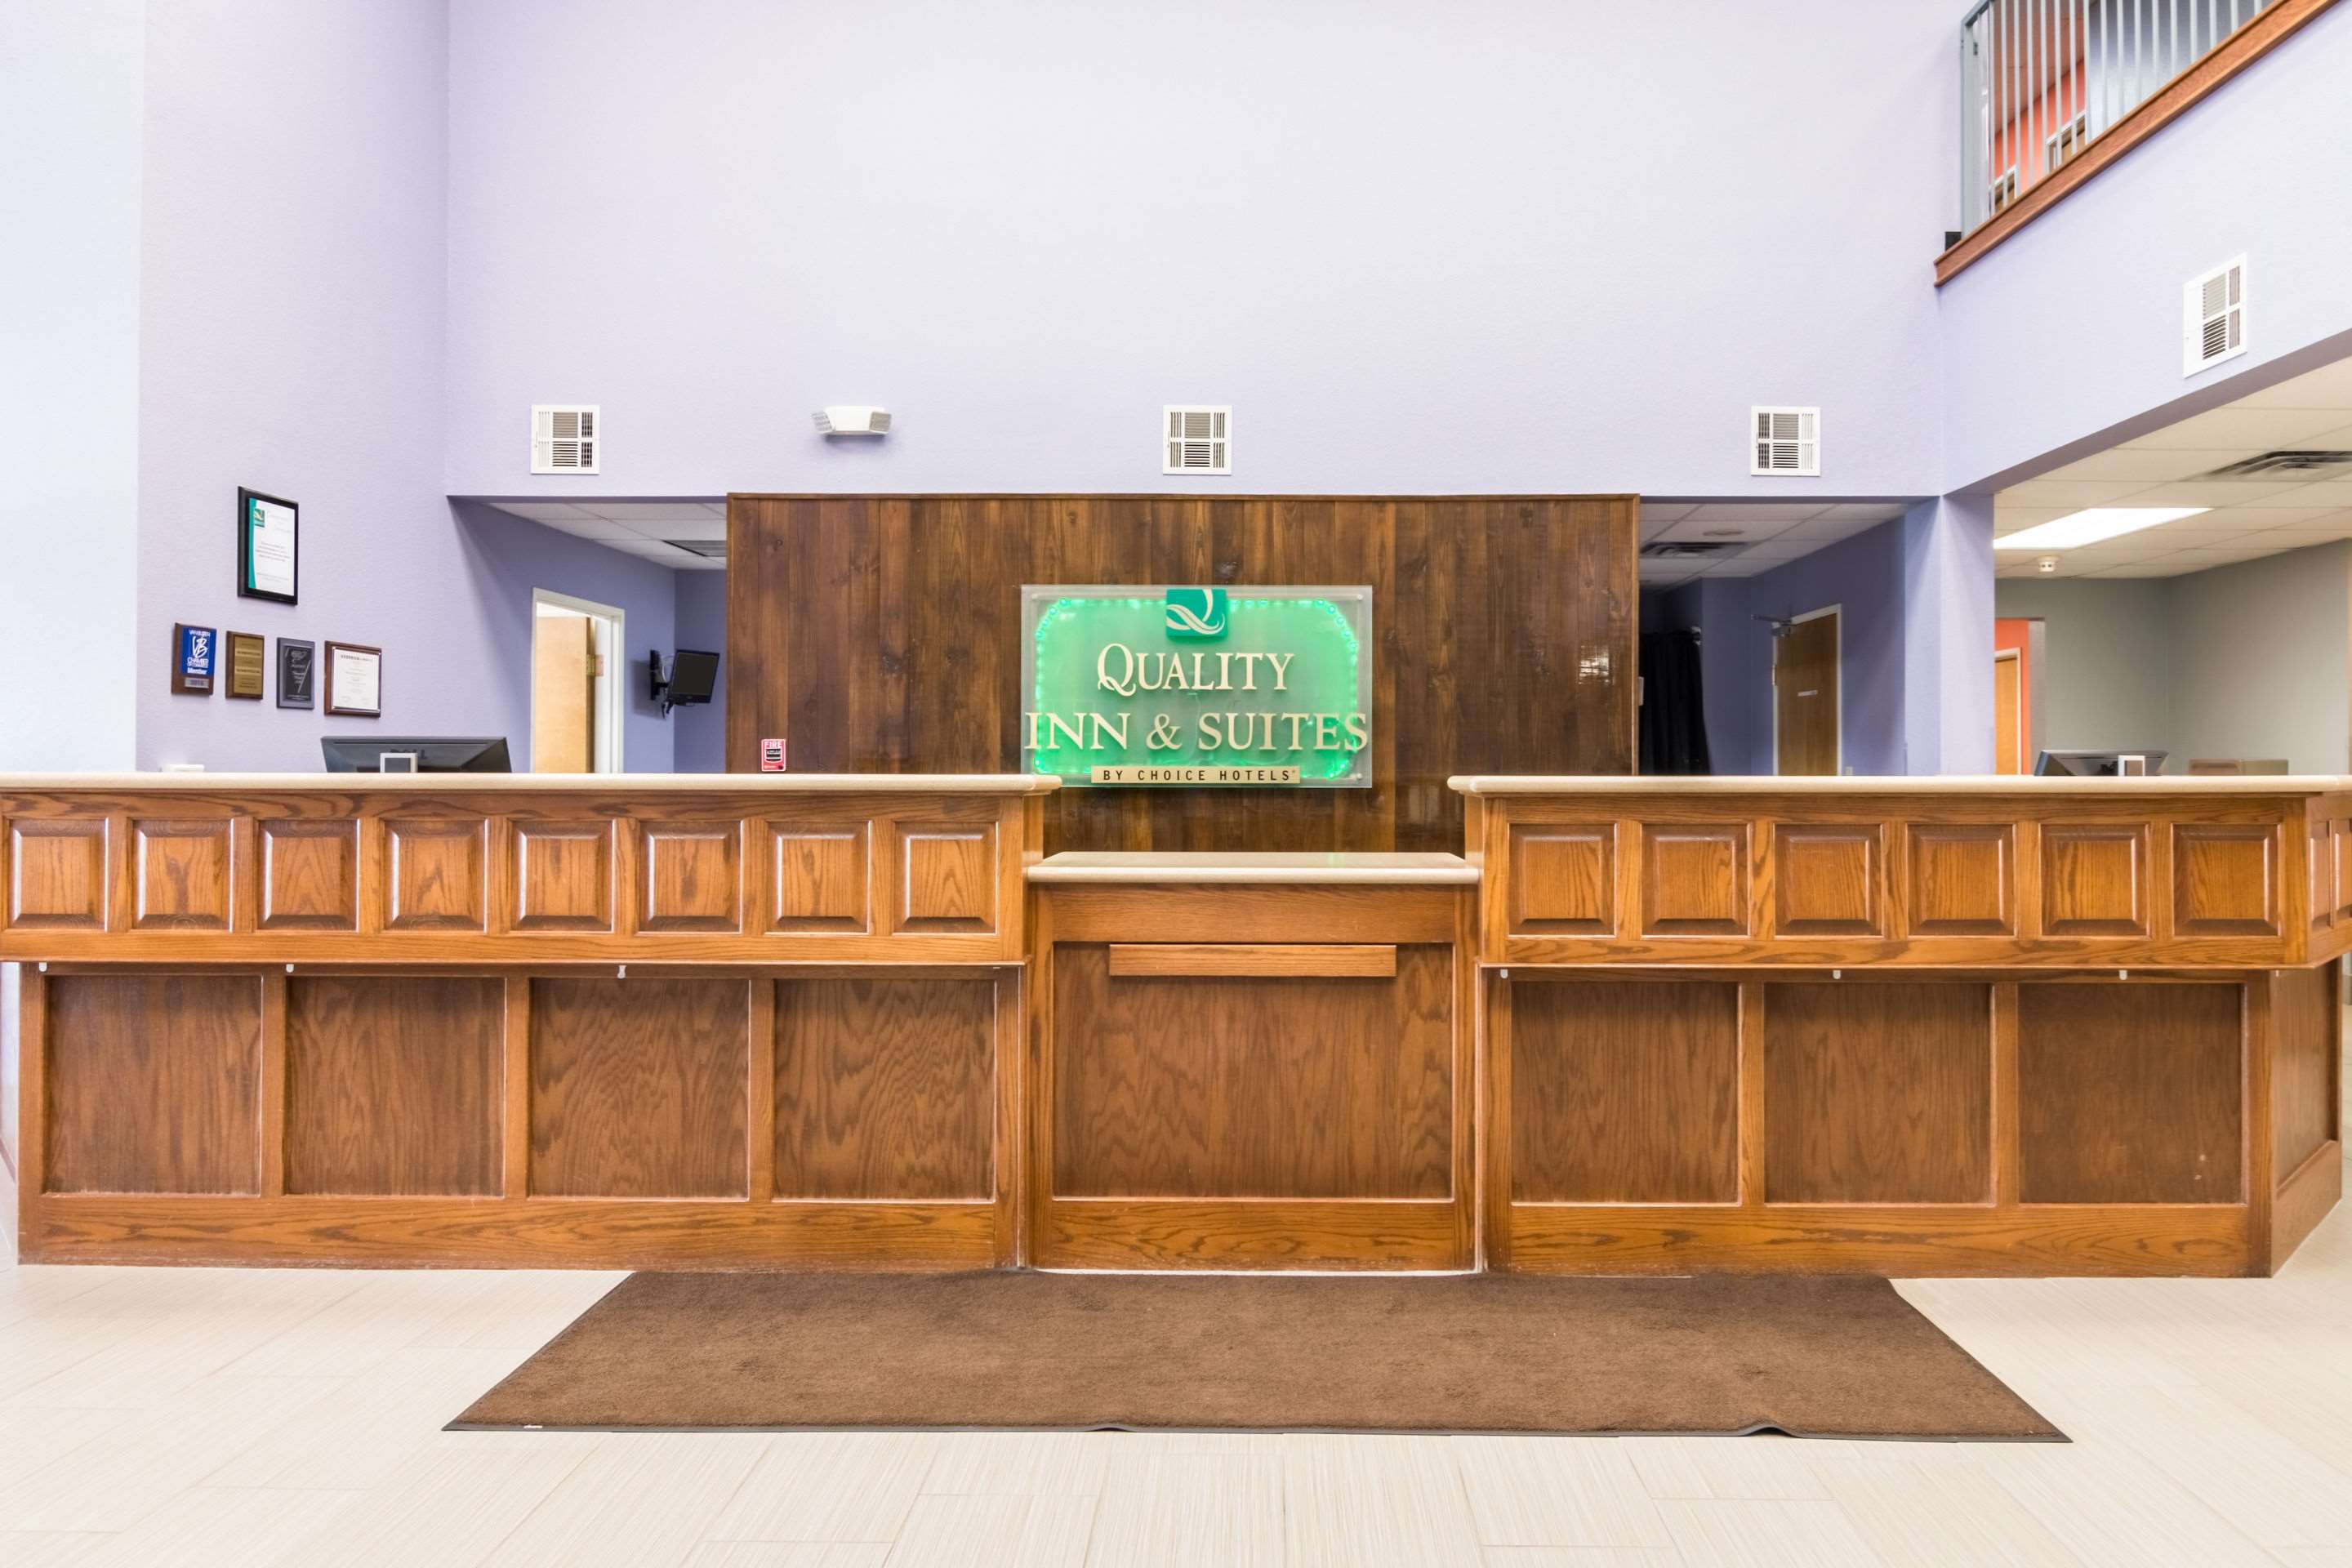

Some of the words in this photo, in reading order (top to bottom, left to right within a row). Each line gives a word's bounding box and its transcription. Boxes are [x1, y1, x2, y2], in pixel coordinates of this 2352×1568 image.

[1024, 712, 1131, 751] INN
[1145, 713, 1183, 751] &
[1198, 712, 1369, 752] SUITES
[764, 741, 783, 749] FIRE
[1103, 770, 1124, 781] BY
[1138, 770, 1206, 781] CHOICE
